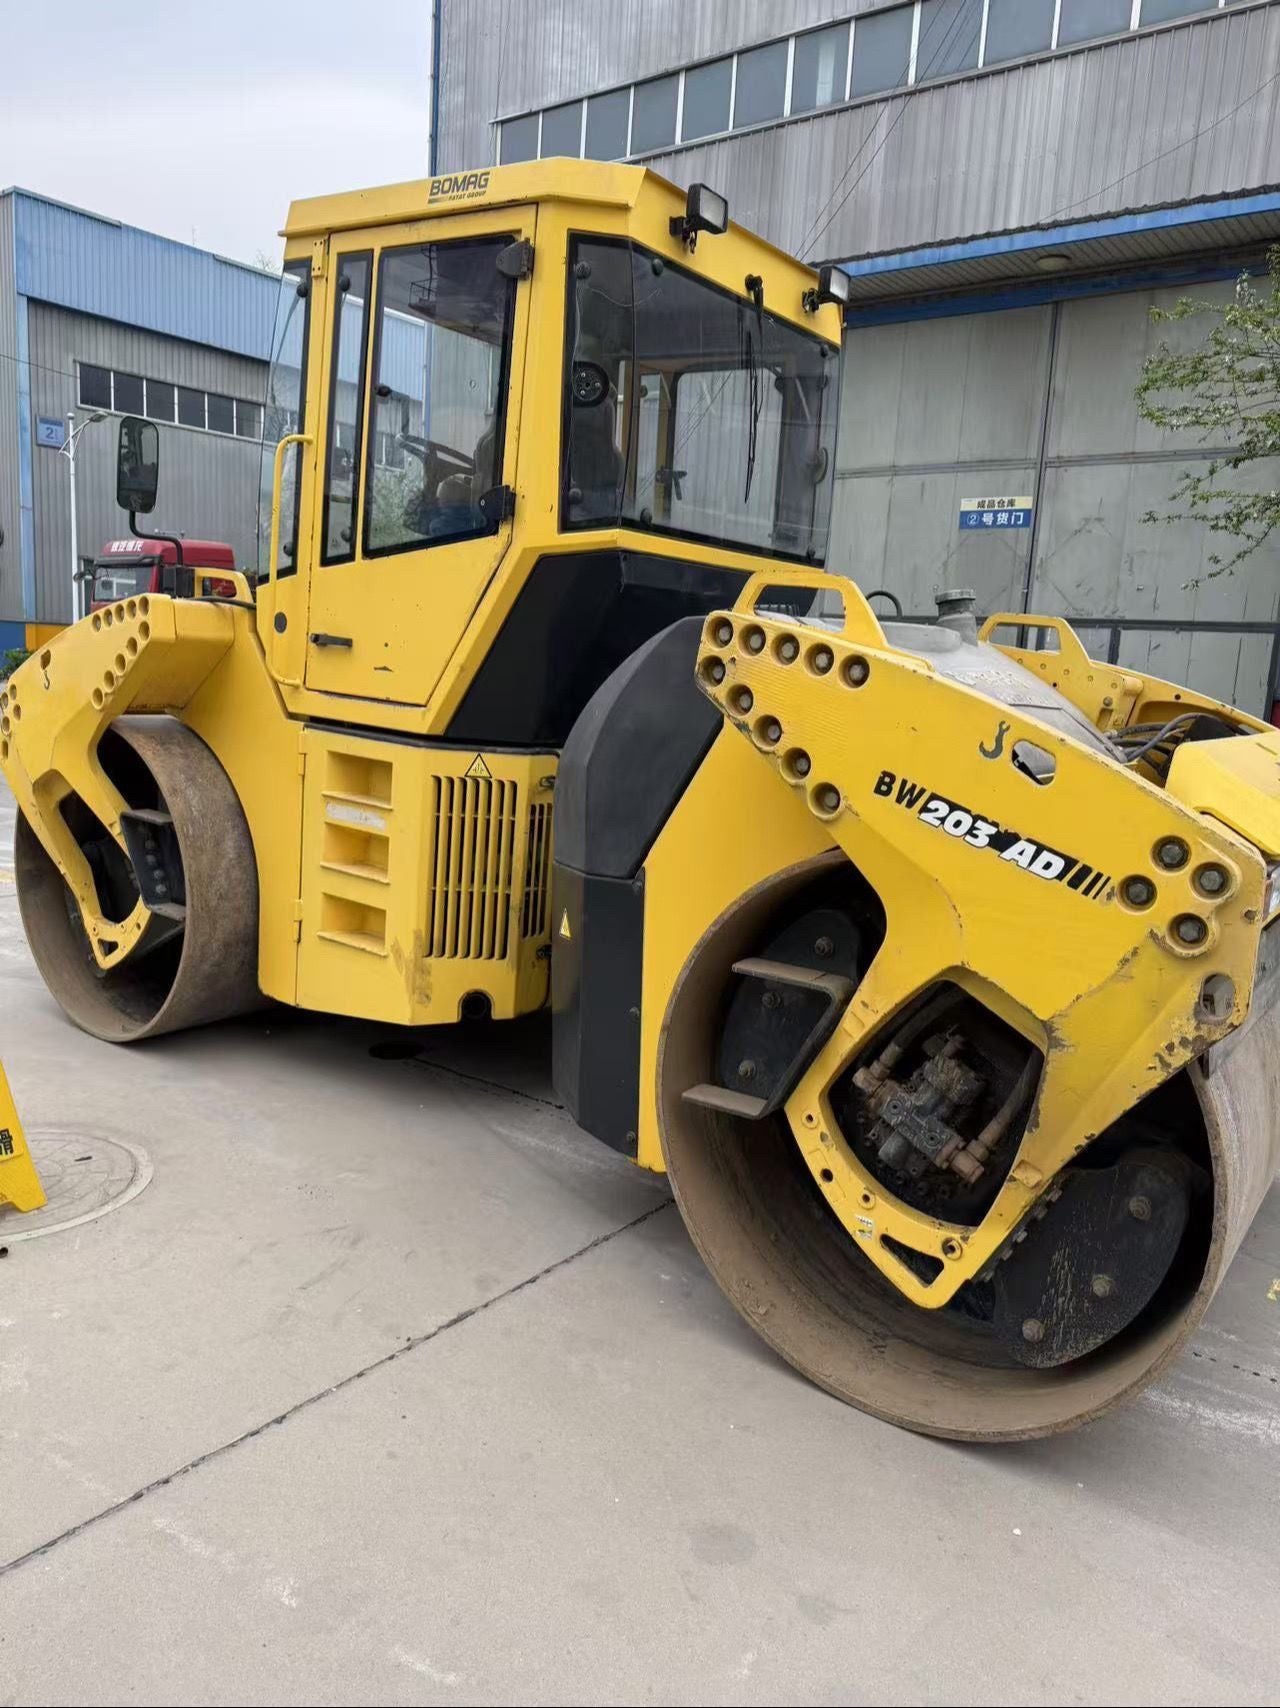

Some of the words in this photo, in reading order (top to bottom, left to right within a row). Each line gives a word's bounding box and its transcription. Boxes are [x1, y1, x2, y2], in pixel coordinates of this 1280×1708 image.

[430, 171, 490, 196] BOMAG
[976, 498, 1016, 509] 成品仓库
[873, 770, 926, 810] BW
[917, 799, 998, 849] 203
[998, 839, 1066, 880] AD
